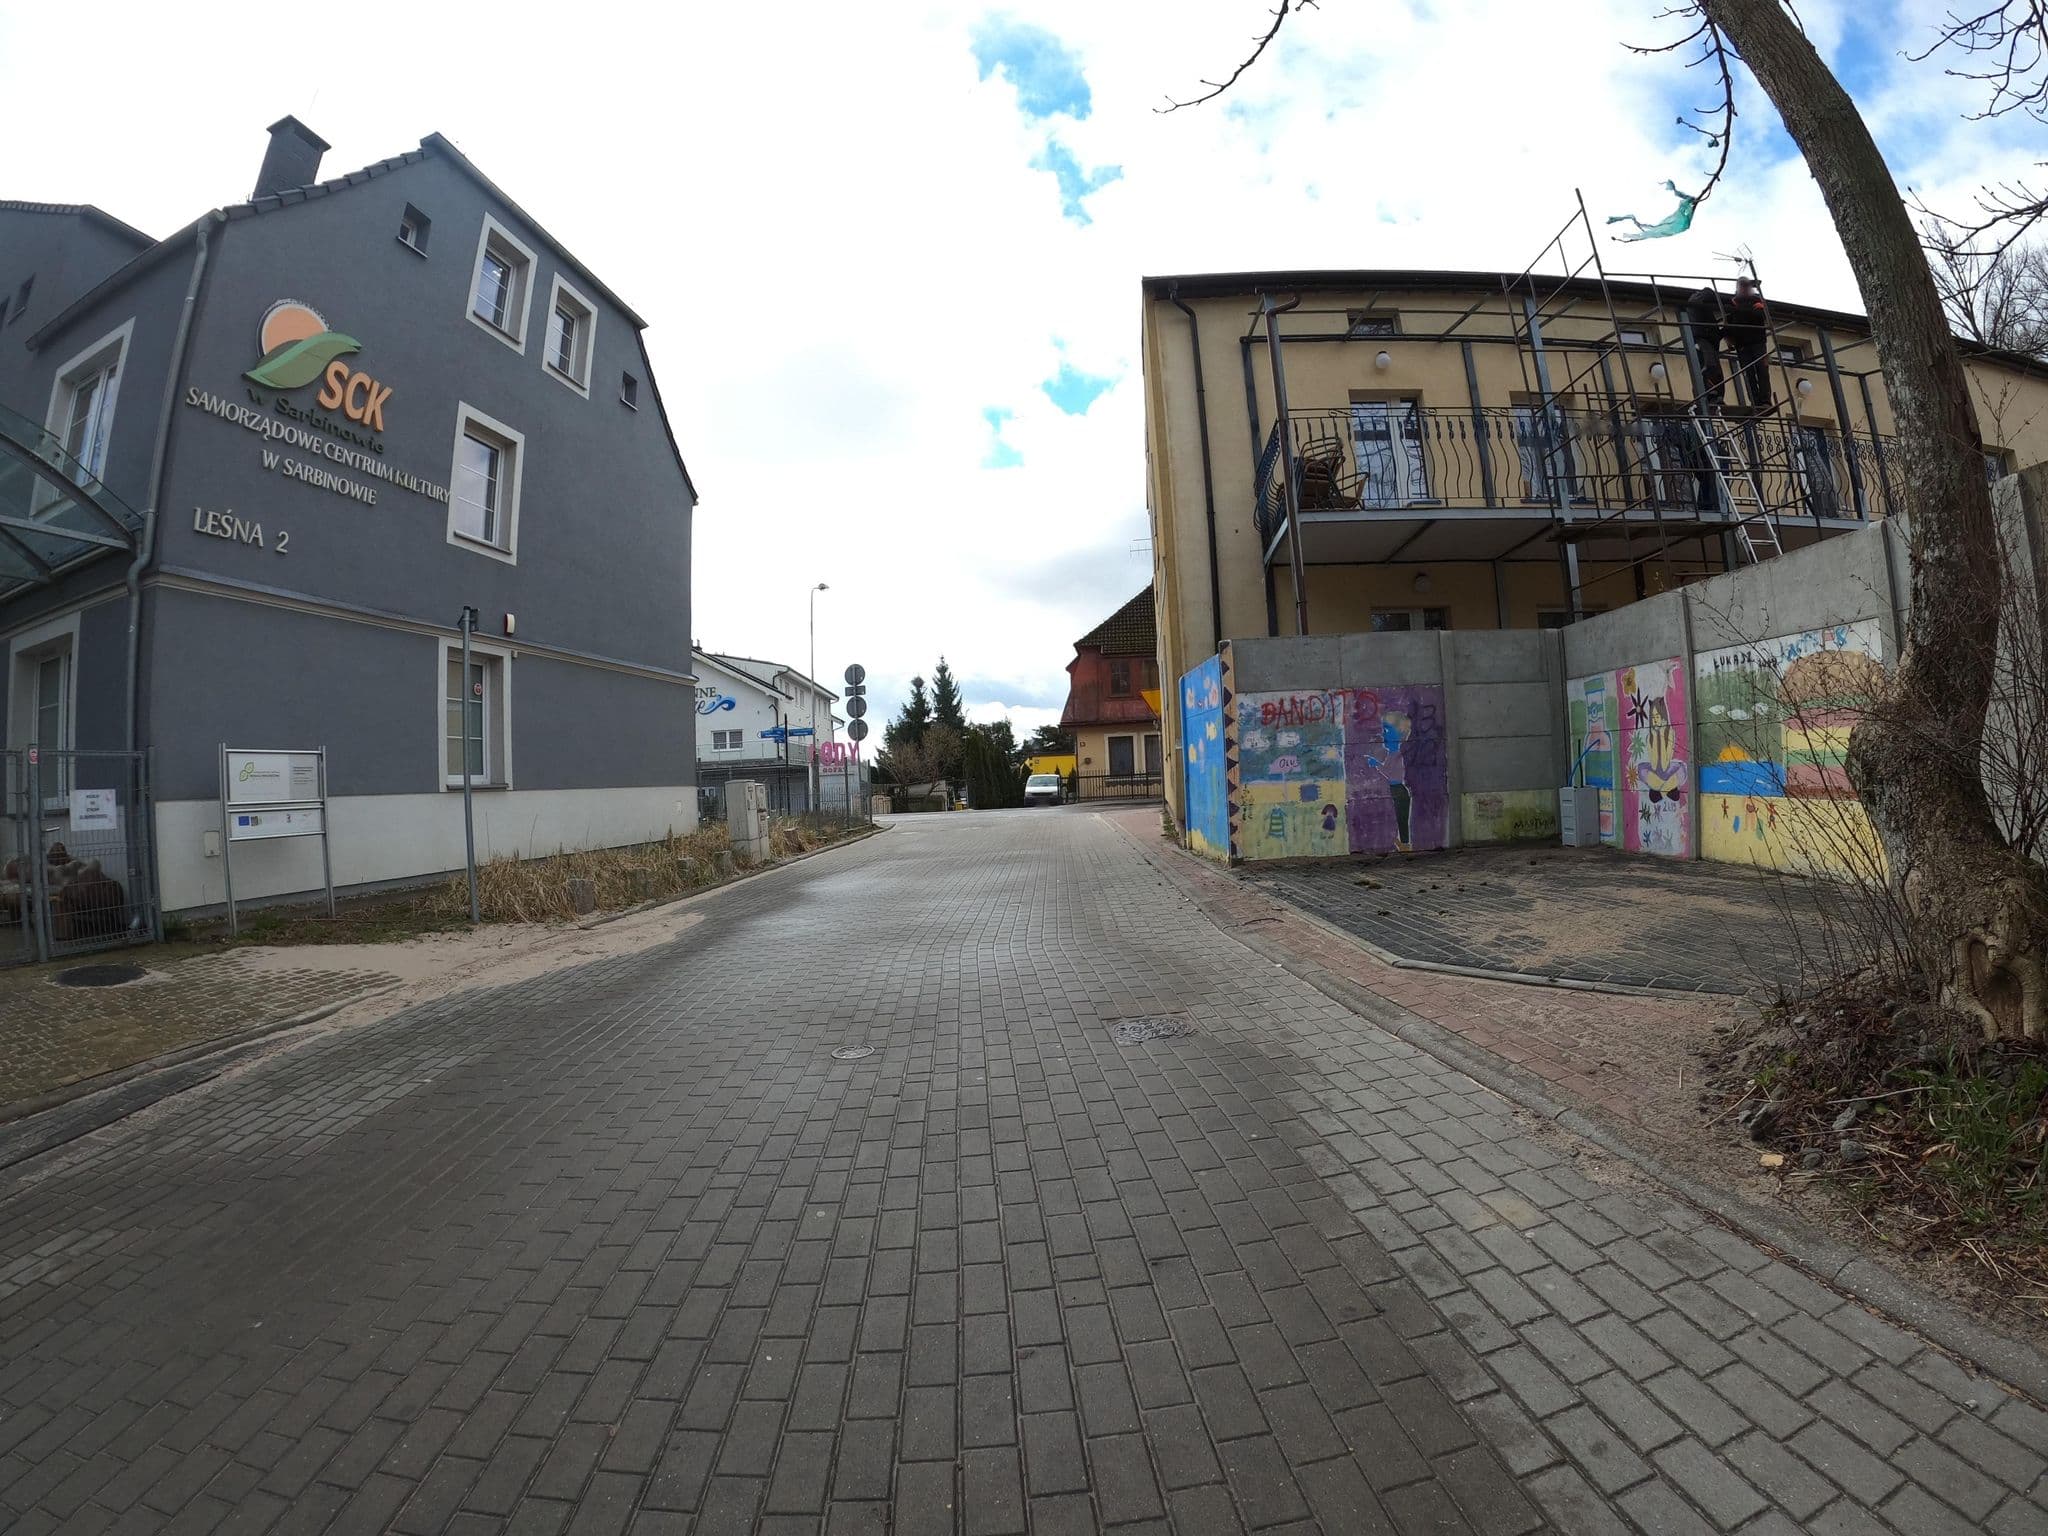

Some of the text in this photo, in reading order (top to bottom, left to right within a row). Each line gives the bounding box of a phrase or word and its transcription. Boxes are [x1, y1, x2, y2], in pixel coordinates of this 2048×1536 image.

[317, 360, 393, 432] SCK
[186, 387, 450, 504] SAMORZĄDOWE CENTRUM KULTURY
[275, 397, 384, 454] Sarbinowie
[262, 449, 377, 505] W SARBINOWIE
[193, 508, 289, 553] LEŚNA 2
[1260, 688, 1379, 729] BANDITO
